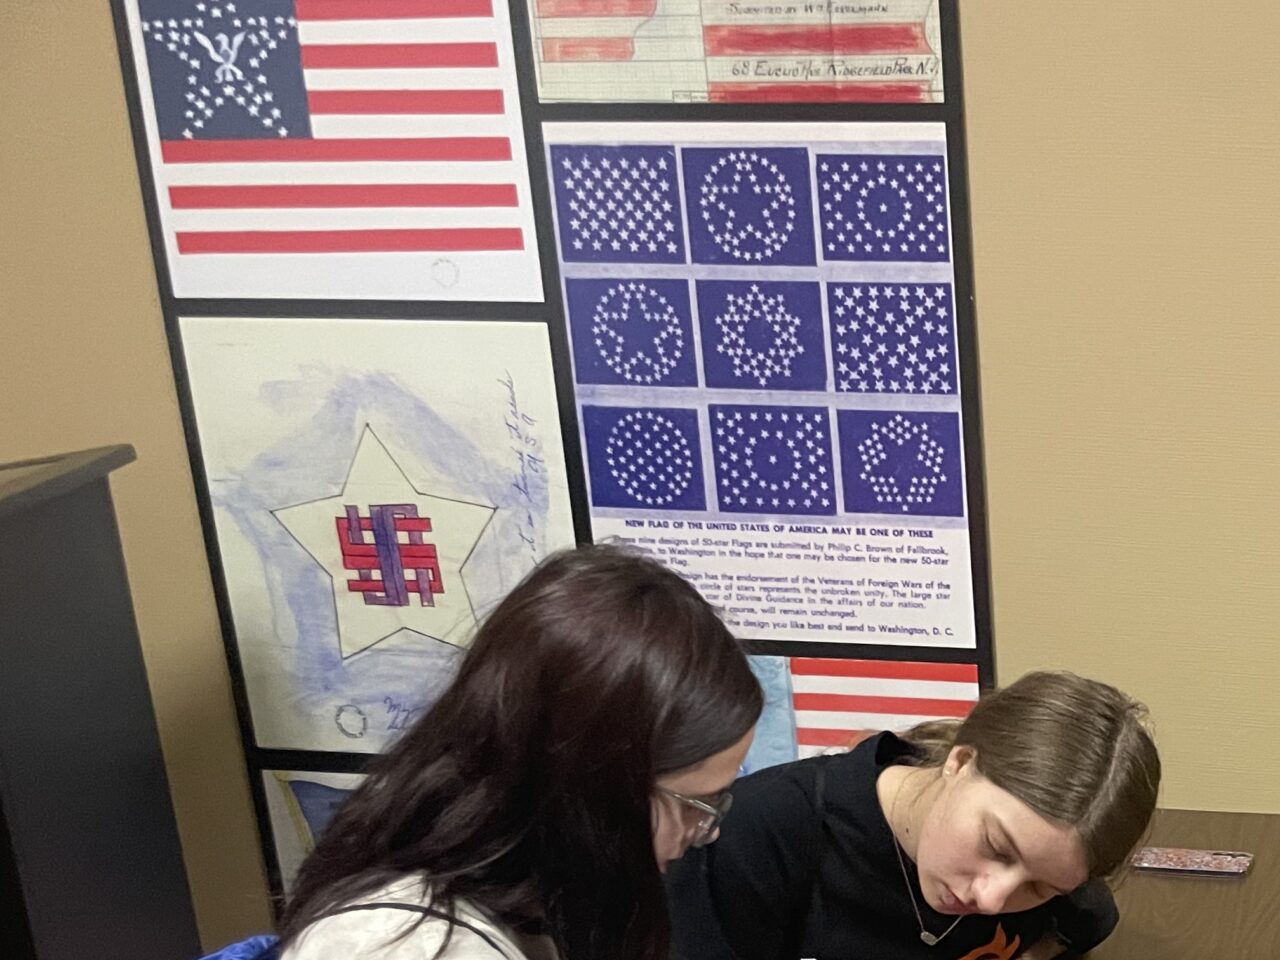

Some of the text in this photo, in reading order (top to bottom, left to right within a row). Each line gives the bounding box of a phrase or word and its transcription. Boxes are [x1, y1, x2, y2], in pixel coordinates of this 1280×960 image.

[732, 60, 750, 76] 68
[625, 520, 644, 528] NEW
[648, 521, 669, 529] FLAG
[688, 522, 703, 530] THE
[706, 523, 737, 531] UNITED
[740, 524, 770, 532] STATES
[773, 525, 785, 533] OF
[789, 526, 828, 534] AMERICA
[832, 527, 852, 535] MAY
[856, 528, 866, 536] BE
[870, 528, 889, 537] ONE
[892, 529, 905, 537] OF
[908, 530, 934, 538] THESE
[658, 537, 689, 546] designs
[702, 538, 729, 546] 50-star
[732, 539, 752, 549] Flags
[771, 541, 811, 550] submitted
[814, 542, 824, 552] by
[828, 543, 851, 553] Philip
[854, 544, 863, 552] C.
[866, 544, 893, 553] Brown
[896, 545, 905, 554] of
[908, 546, 949, 556] Fallbrook,
[668, 547, 716, 558] Washington
[719, 549, 727, 557] in
[729, 549, 742, 558] the
[745, 549, 765, 560] hope
[768, 551, 783, 560] that
[804, 554, 821, 562] may
[824, 553, 835, 561] be
[838, 554, 866, 562] chosen
[869, 554, 880, 563] for
[884, 555, 897, 563] the
[921, 556, 949, 565] 50-star
[705, 572, 719, 580] has
[721, 572, 734, 580] the
[736, 574, 788, 583] endorsement
[802, 576, 816, 584] the
[818, 576, 854, 586] Veterans
[857, 578, 866, 587] of
[868, 579, 899, 589] Foreign
[902, 580, 923, 589] Wars
[926, 580, 934, 589] of
[938, 581, 951, 590] the
[700, 582, 721, 590] circle
[725, 583, 733, 591] of
[737, 584, 756, 592] stars
[760, 586, 801, 594] represents
[804, 586, 818, 595] the
[822, 588, 861, 597] unbroken
[892, 590, 907, 599] The
[911, 590, 932, 601] large
[936, 592, 951, 600] star
[724, 593, 732, 601] of
[736, 594, 762, 602] Divine
[766, 594, 804, 604] Guidance
[808, 596, 816, 604] in
[820, 596, 833, 605] the
[838, 598, 863, 607] affairs
[867, 599, 877, 608] of
[898, 600, 926, 609] nation.
[761, 606, 776, 615] will
[780, 607, 807, 616] remain
[811, 608, 858, 619] unchanged.
[744, 620, 770, 629] design
[772, 622, 788, 630] you
[790, 621, 805, 630] like
[808, 622, 825, 630] best
[828, 623, 843, 631] and
[846, 624, 865, 632] send
[868, 625, 877, 633] to
[878, 625, 930, 636] Washington,
[932, 627, 942, 636] D.
[945, 628, 954, 636] C.
